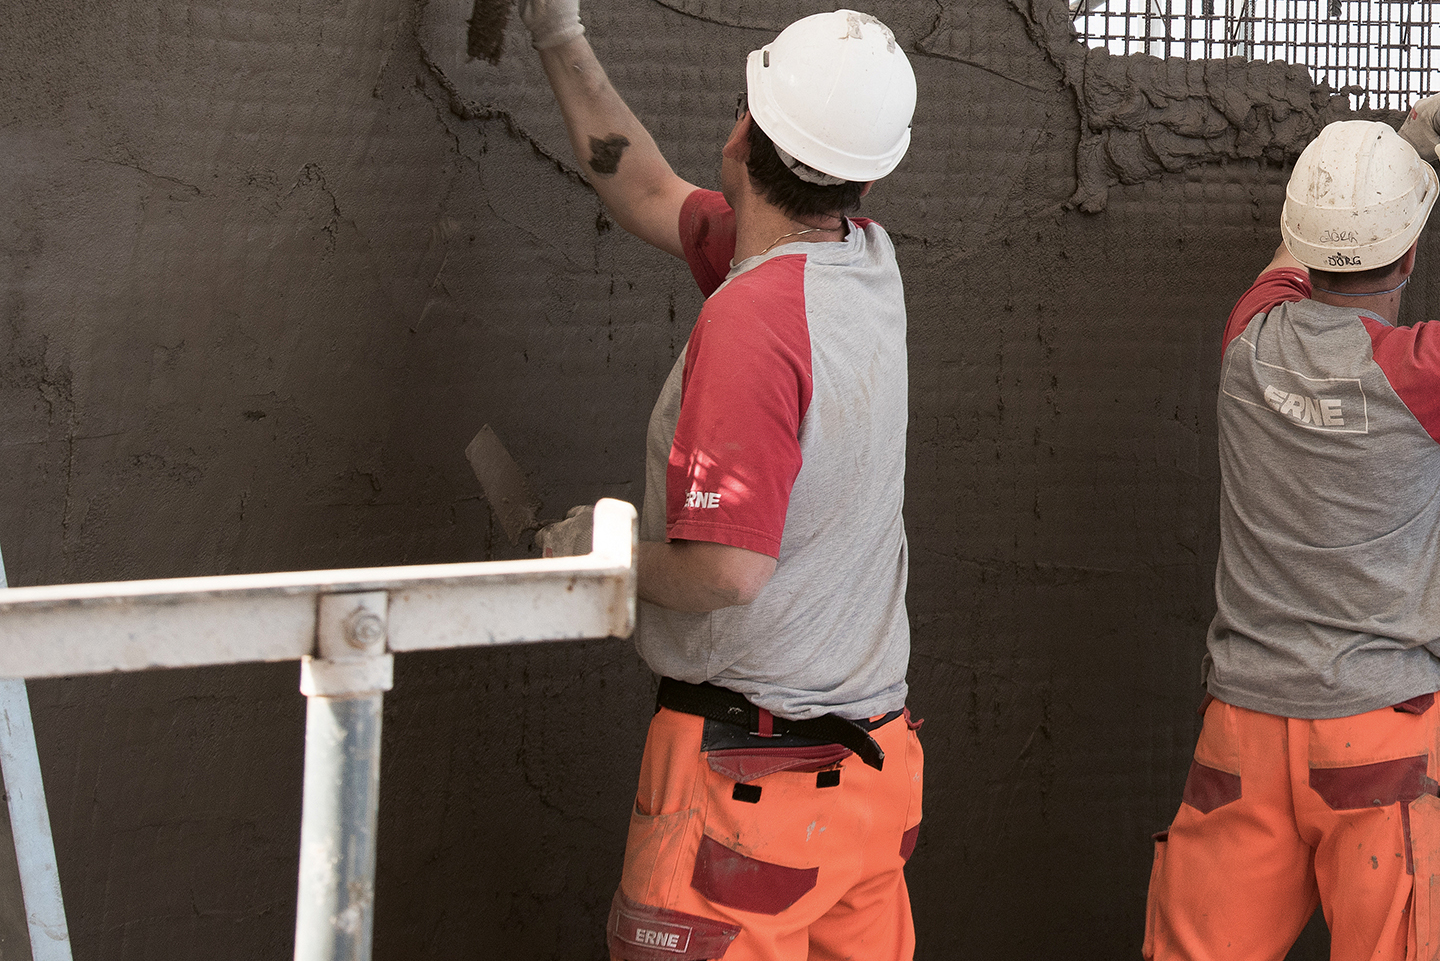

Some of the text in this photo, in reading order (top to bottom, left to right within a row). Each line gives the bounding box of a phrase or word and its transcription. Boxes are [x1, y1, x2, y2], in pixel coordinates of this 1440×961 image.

[1327, 252, 1362, 267] JÖRG
[1264, 384, 1345, 426] ERNE
[635, 928, 680, 948] ERNE
